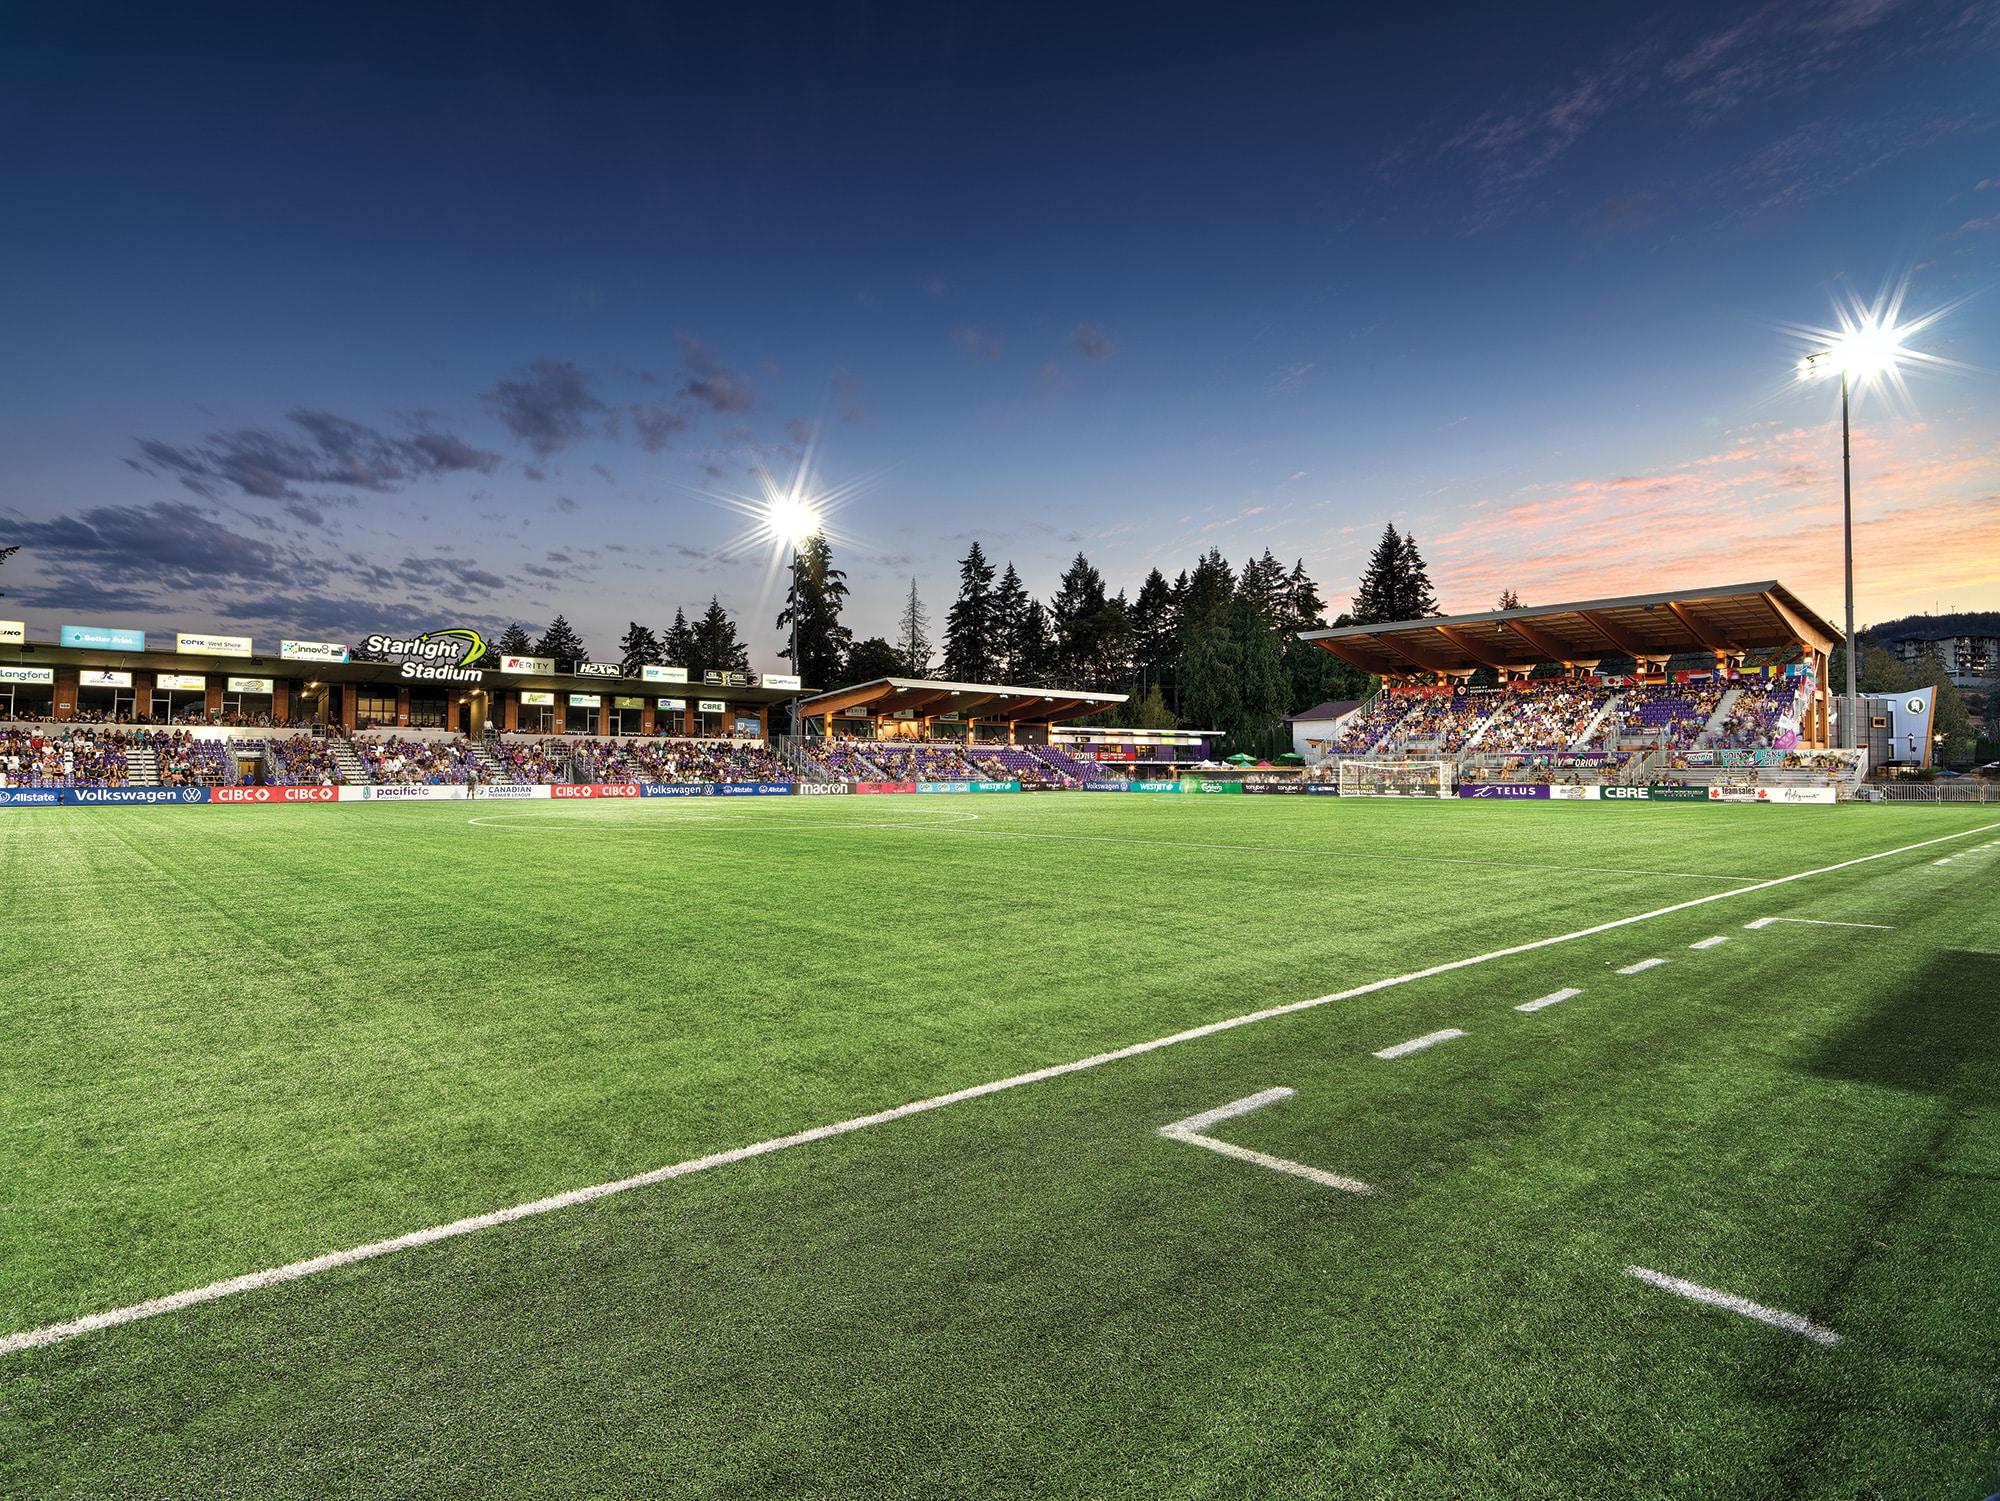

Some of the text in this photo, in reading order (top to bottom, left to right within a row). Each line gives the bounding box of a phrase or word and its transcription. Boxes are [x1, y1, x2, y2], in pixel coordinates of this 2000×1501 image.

[84, 635, 111, 643] Better
[298, 645, 329, 654] innov8
[367, 635, 459, 659] Starlight
[508, 659, 549, 669] VERITY
[579, 663, 606, 674] H2X
[0, 670, 50, 680] Langford
[401, 662, 483, 681] Stadium
[555, 786, 581, 797] CIBC
[602, 785, 626, 796] CIBC
[646, 785, 701, 795] Volkswagen
[801, 783, 848, 794] macron
[1086, 782, 1119, 791] Volkswagen
[1245, 784, 1265, 792] tonybet
[1496, 787, 1536, 795] TELUS
[75, 789, 176, 802] Volkswagen
[218, 789, 254, 801] CIBC
[285, 788, 318, 800] CIBC
[1605, 787, 1648, 798] CBRE
